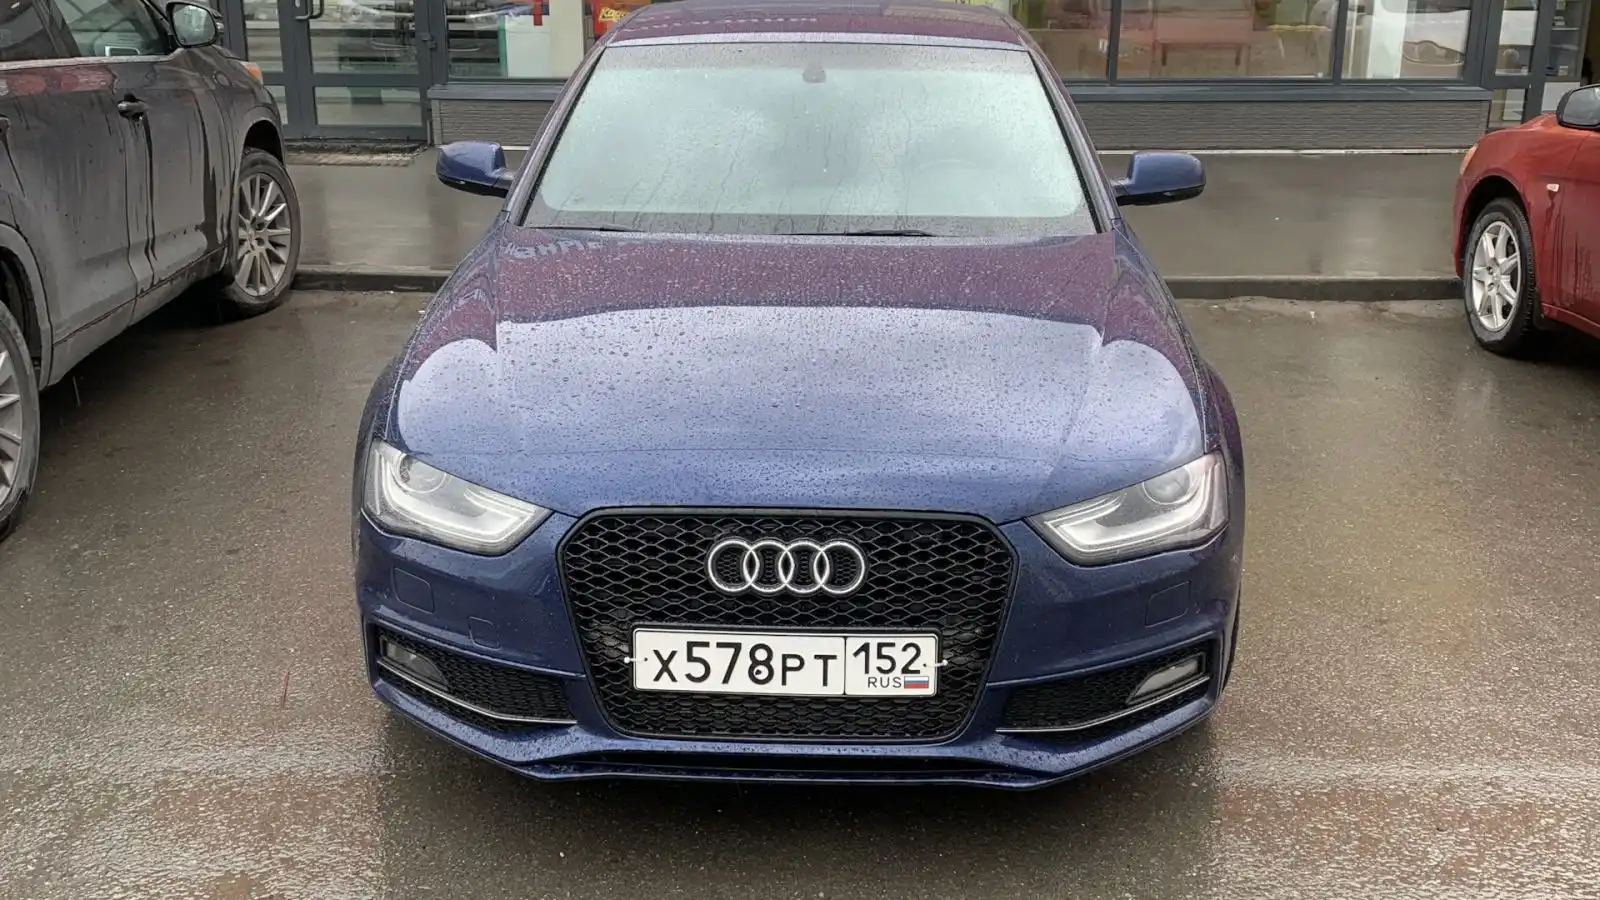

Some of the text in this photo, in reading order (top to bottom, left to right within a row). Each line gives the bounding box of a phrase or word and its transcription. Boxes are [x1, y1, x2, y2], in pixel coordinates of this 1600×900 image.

[653, 641, 922, 687] Х578РТ 152
[868, 677, 902, 688] RUS
